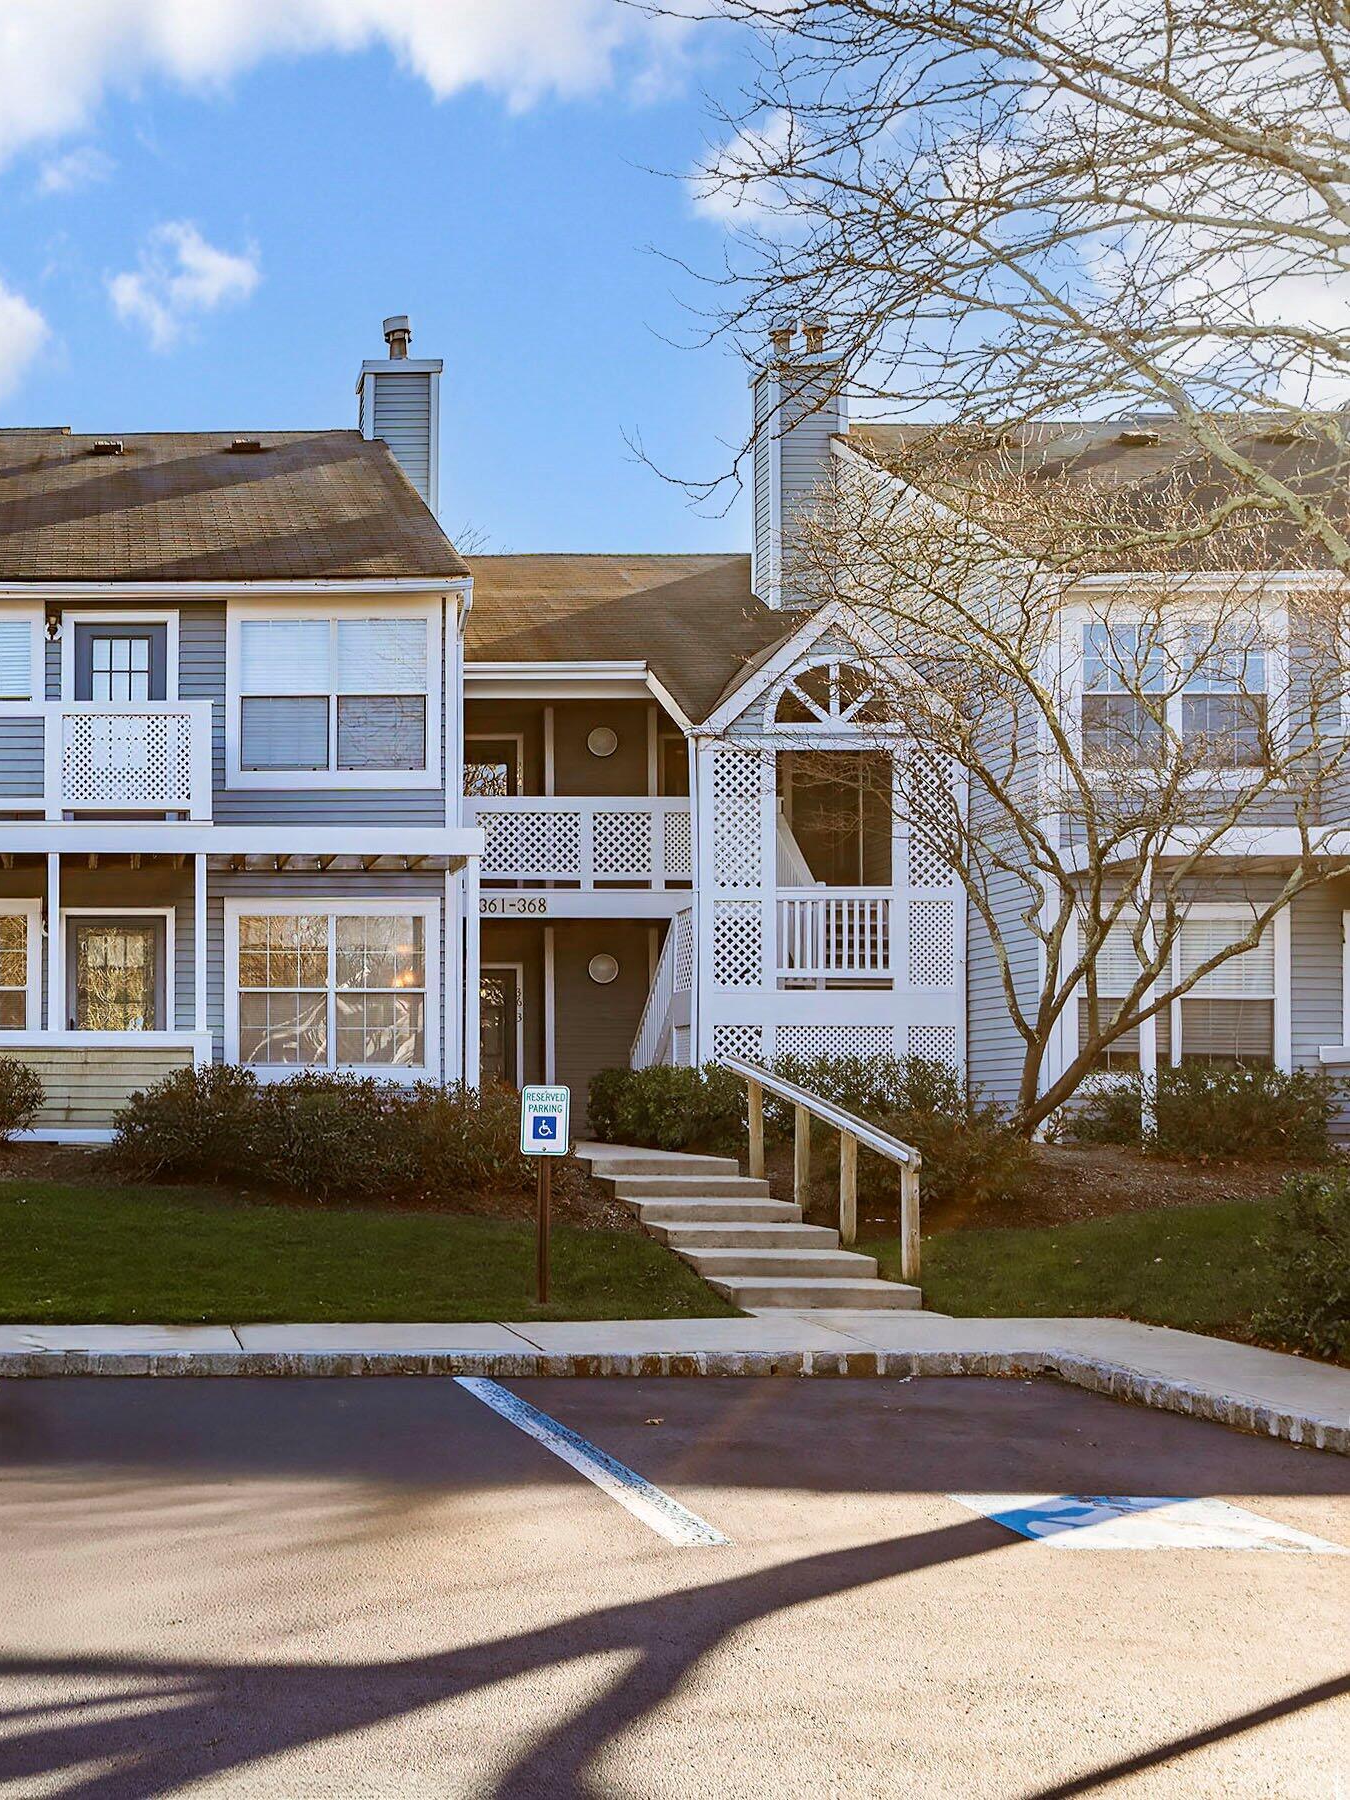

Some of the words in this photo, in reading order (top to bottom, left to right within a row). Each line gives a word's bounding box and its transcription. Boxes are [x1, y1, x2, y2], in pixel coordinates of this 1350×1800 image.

[479, 897, 547, 914] 361-368
[526, 1092, 566, 1102] RESERVED
[528, 1104, 563, 1114] PARKING
